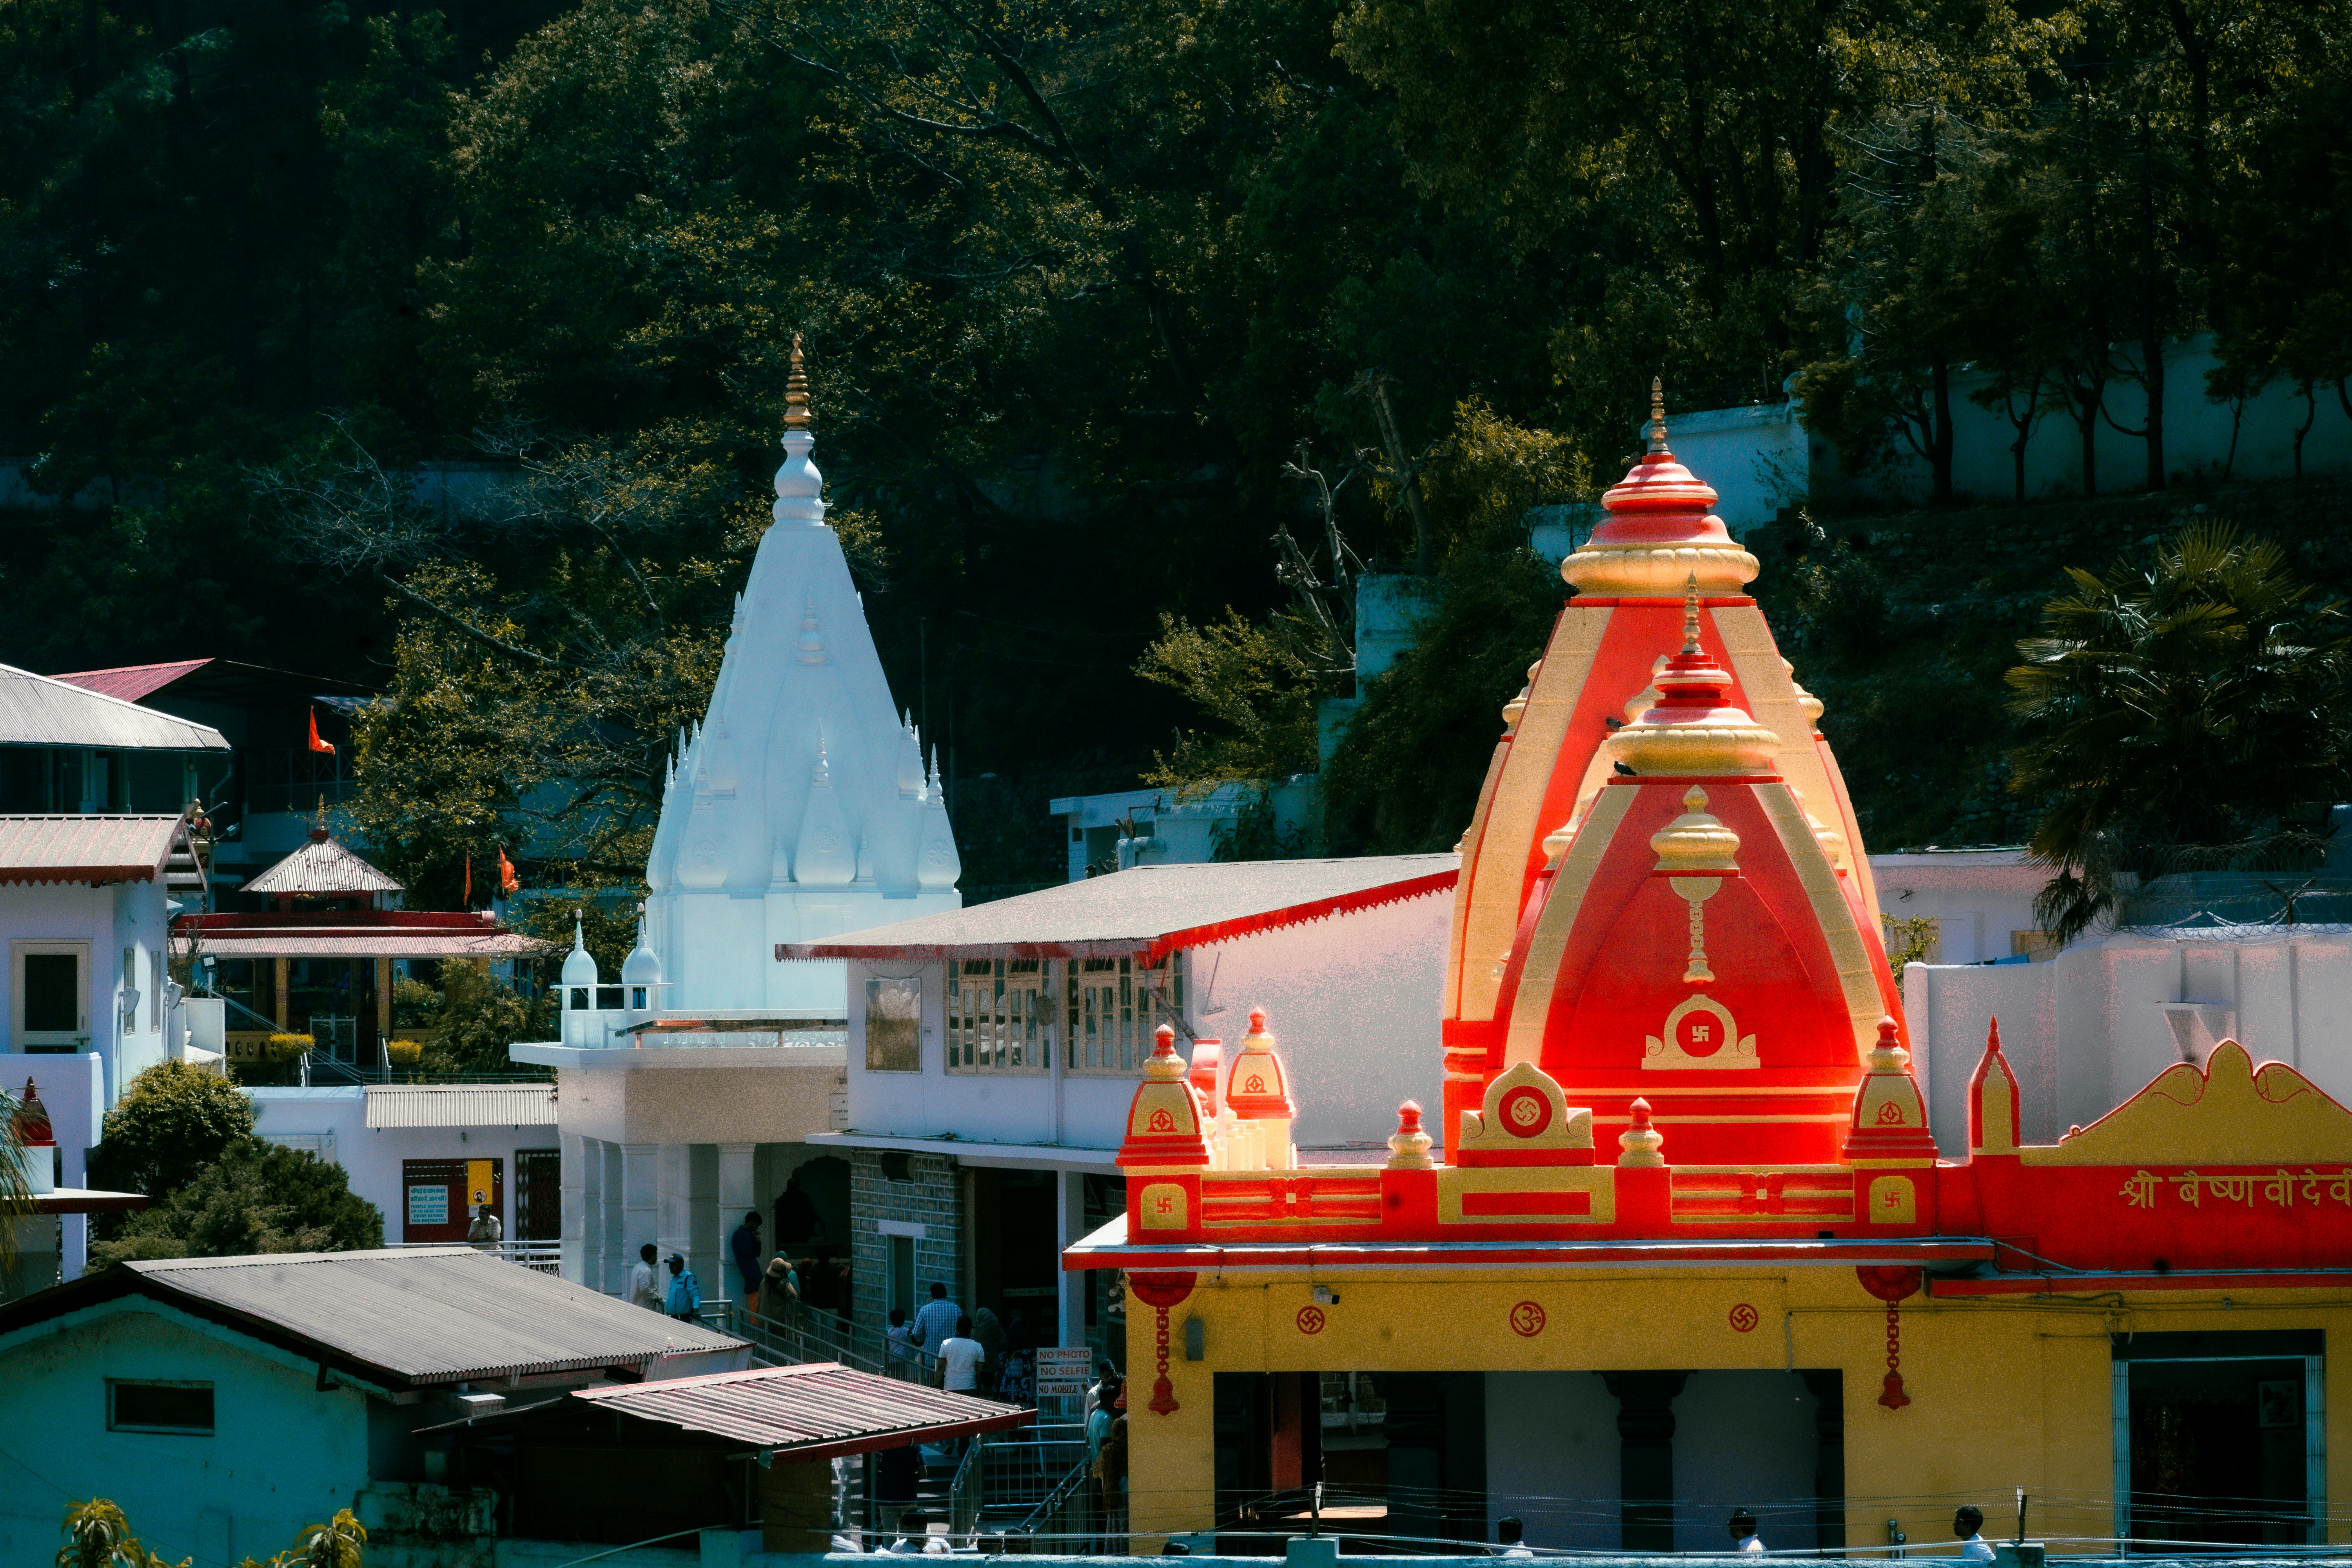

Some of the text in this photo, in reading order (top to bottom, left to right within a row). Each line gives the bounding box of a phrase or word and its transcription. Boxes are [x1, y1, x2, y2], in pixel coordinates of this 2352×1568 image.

[2119, 1169, 2163, 1208] श्री
[1039, 1350, 1090, 1359] NO PHOTO
[1041, 1367, 1090, 1376] NO SELFIE
[1038, 1385, 1078, 1394] NO MOBILE
